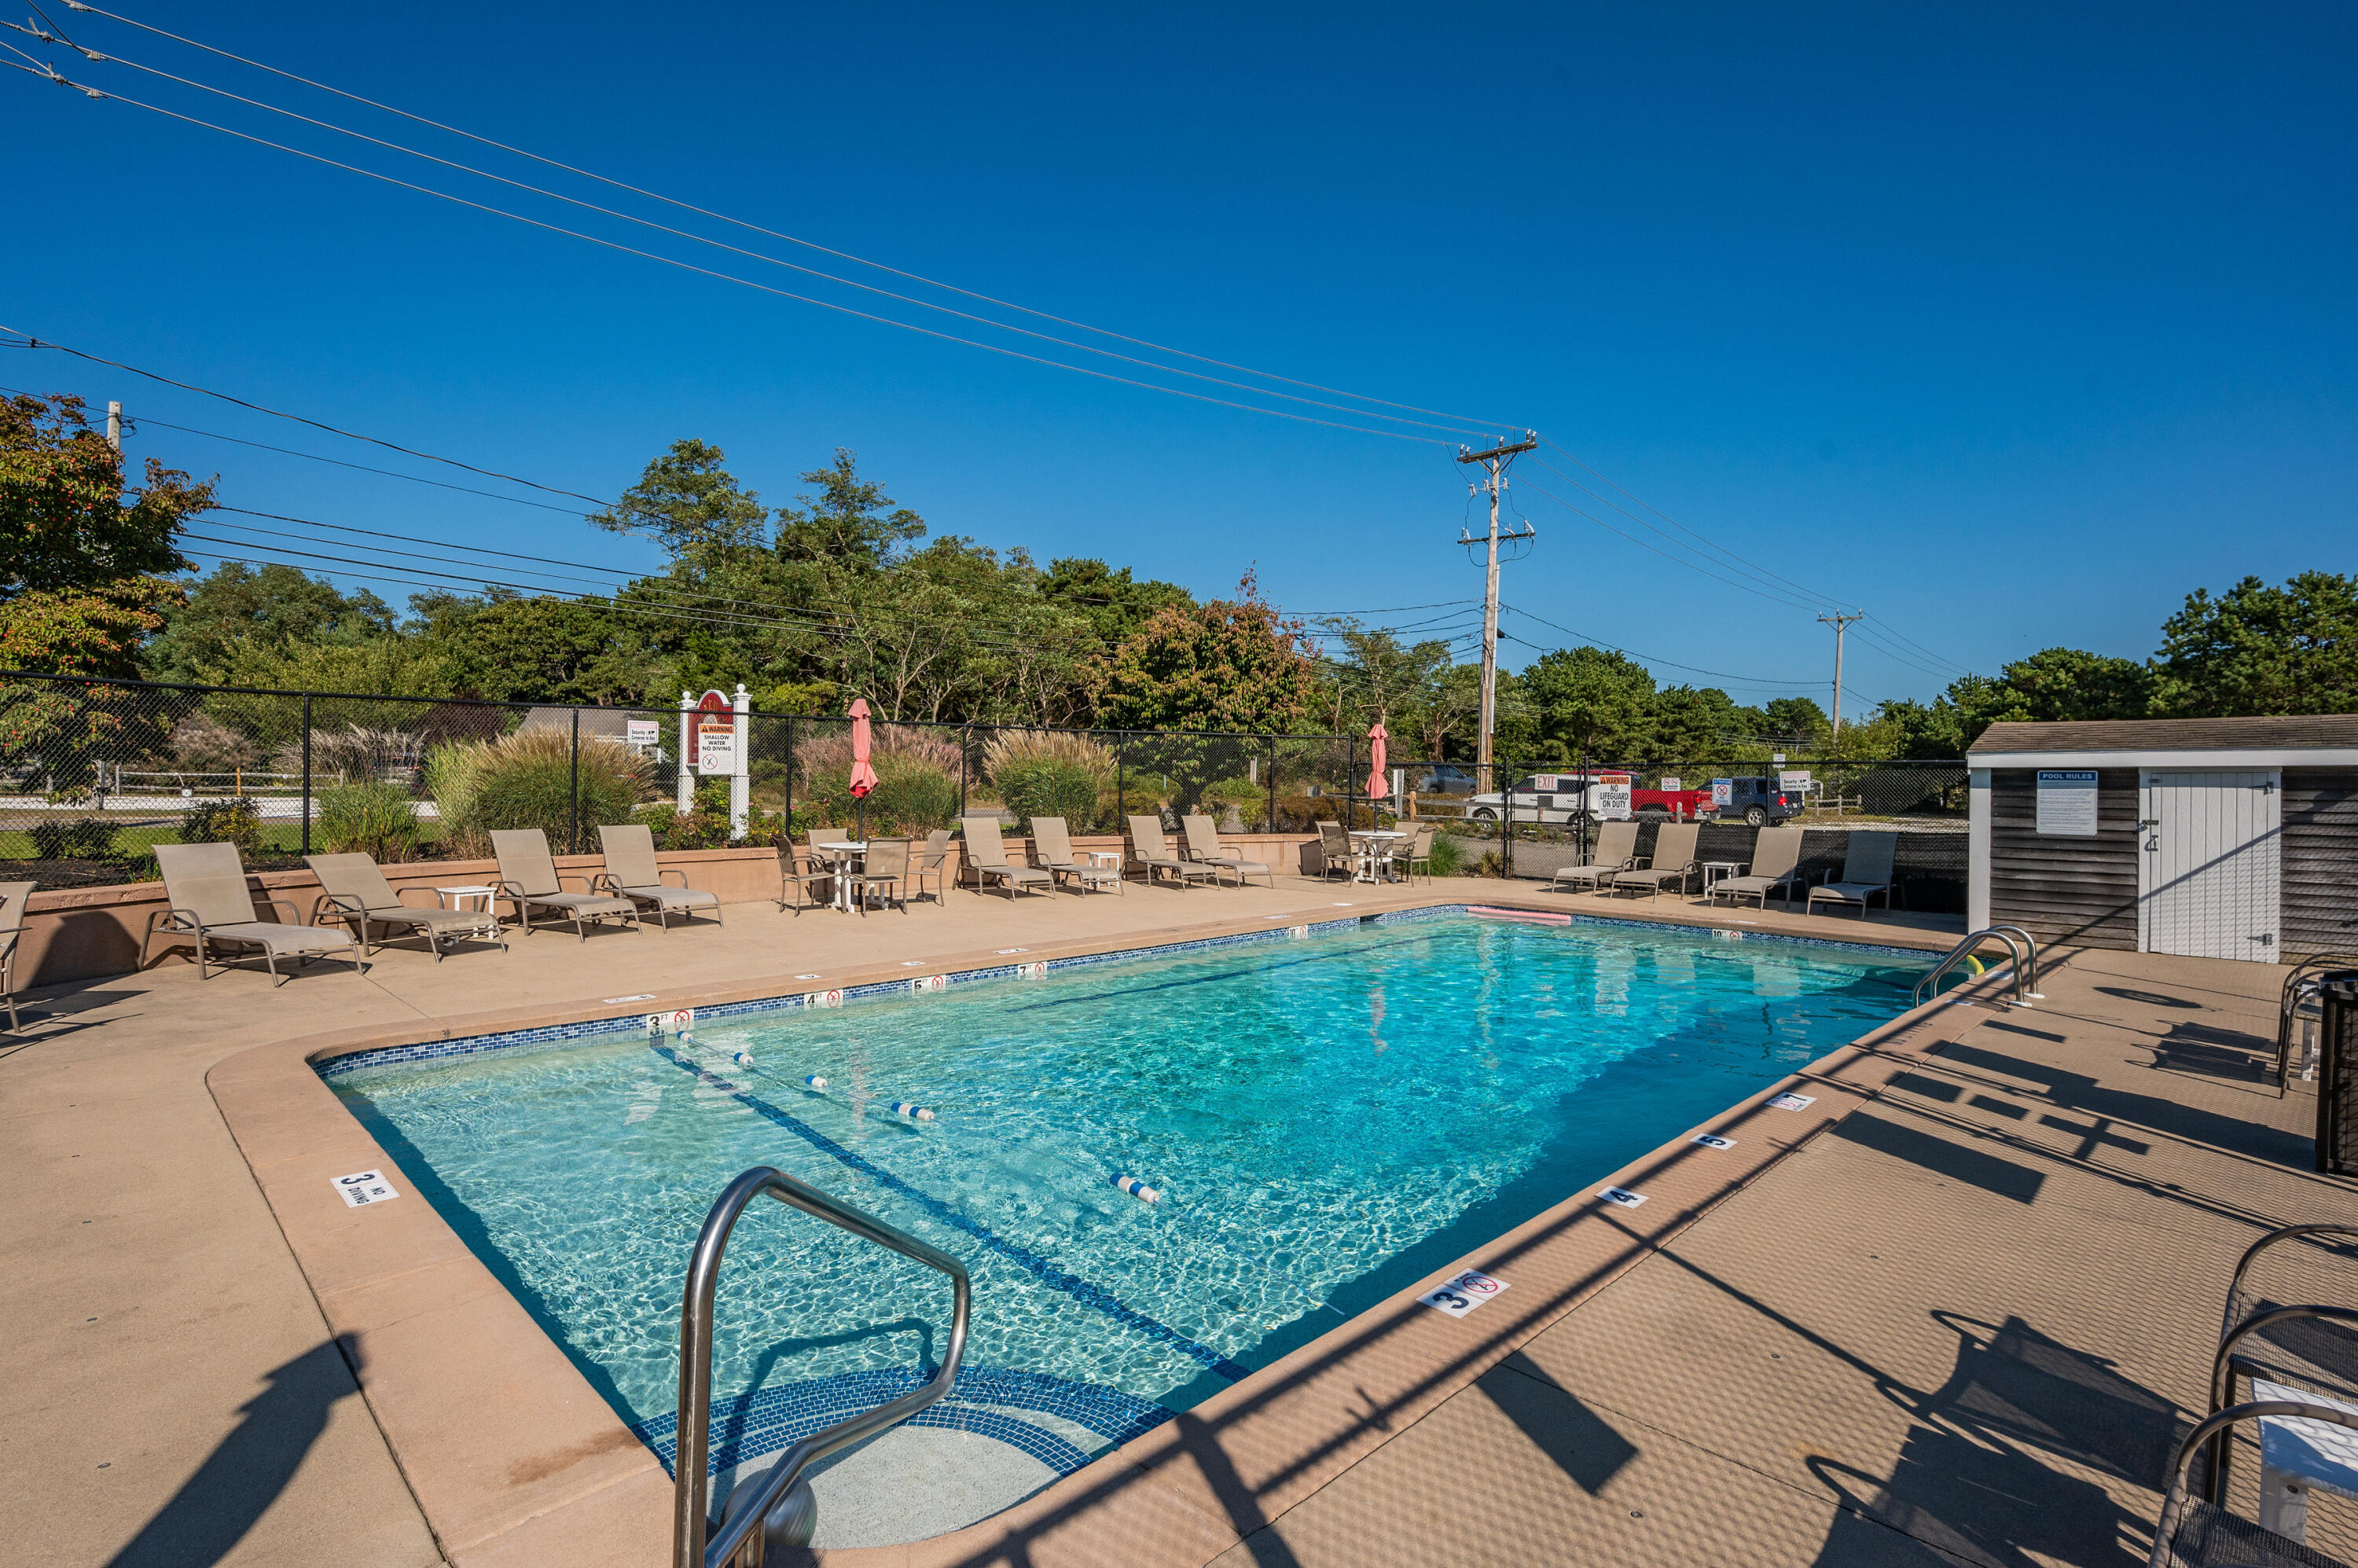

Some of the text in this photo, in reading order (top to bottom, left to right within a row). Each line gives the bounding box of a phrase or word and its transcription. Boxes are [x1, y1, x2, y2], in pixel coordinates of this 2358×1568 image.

[1537, 775, 1555, 789] EXIT
[1290, 928, 1296, 939] 10
[914, 980, 922, 989] 5
[1699, 1136, 1726, 1146] 5
[341, 1174, 375, 1185] 3
[348, 1187, 369, 1204] DIVING
[370, 1187, 386, 1195] NO
[1609, 1190, 1639, 1203] 4
[1432, 1291, 1469, 1309] 3
